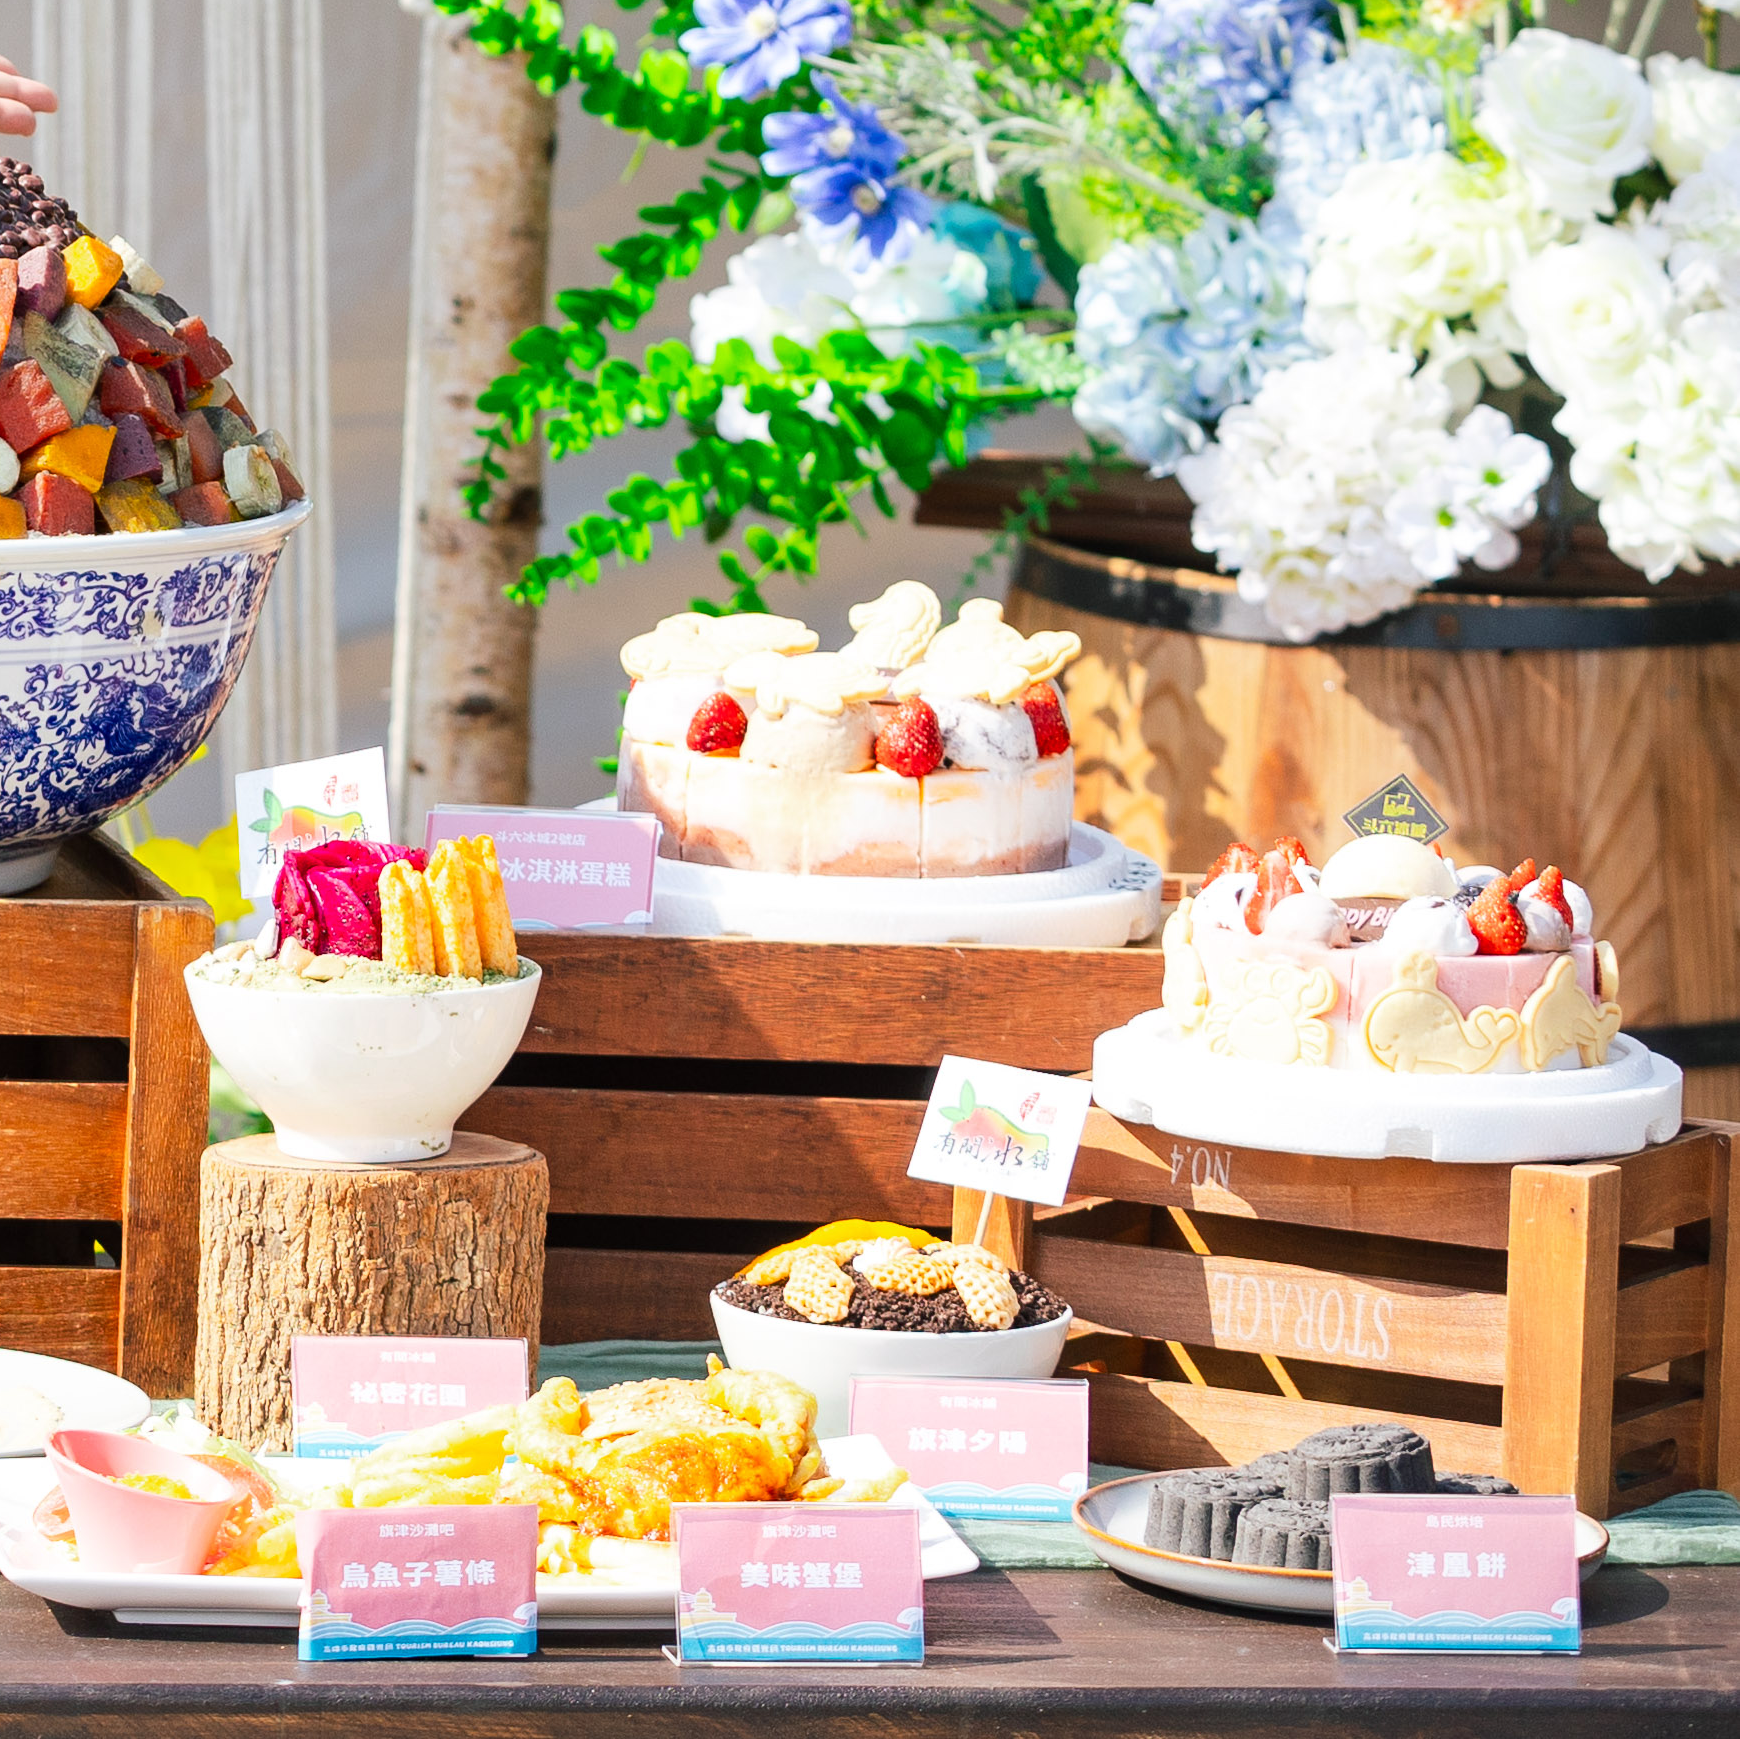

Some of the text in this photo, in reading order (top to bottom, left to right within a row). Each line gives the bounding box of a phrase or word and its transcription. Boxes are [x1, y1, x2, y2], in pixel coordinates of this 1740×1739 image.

[498, 857, 631, 887] 冰淇淋蛋糕
[1170, 1144, 1232, 1193] NO.4
[1212, 1272, 1393, 1359] STORAGE
[907, 1427, 1027, 1455] 旗津夕陽
[379, 1523, 454, 1538] 旗津沙灘吧
[761, 1524, 837, 1539] 旗津沙灘吧
[340, 1560, 496, 1590] 烏魚子薯條
[740, 1561, 864, 1590] 美味蟹堡
[1406, 1551, 1507, 1579] 津凰餅
